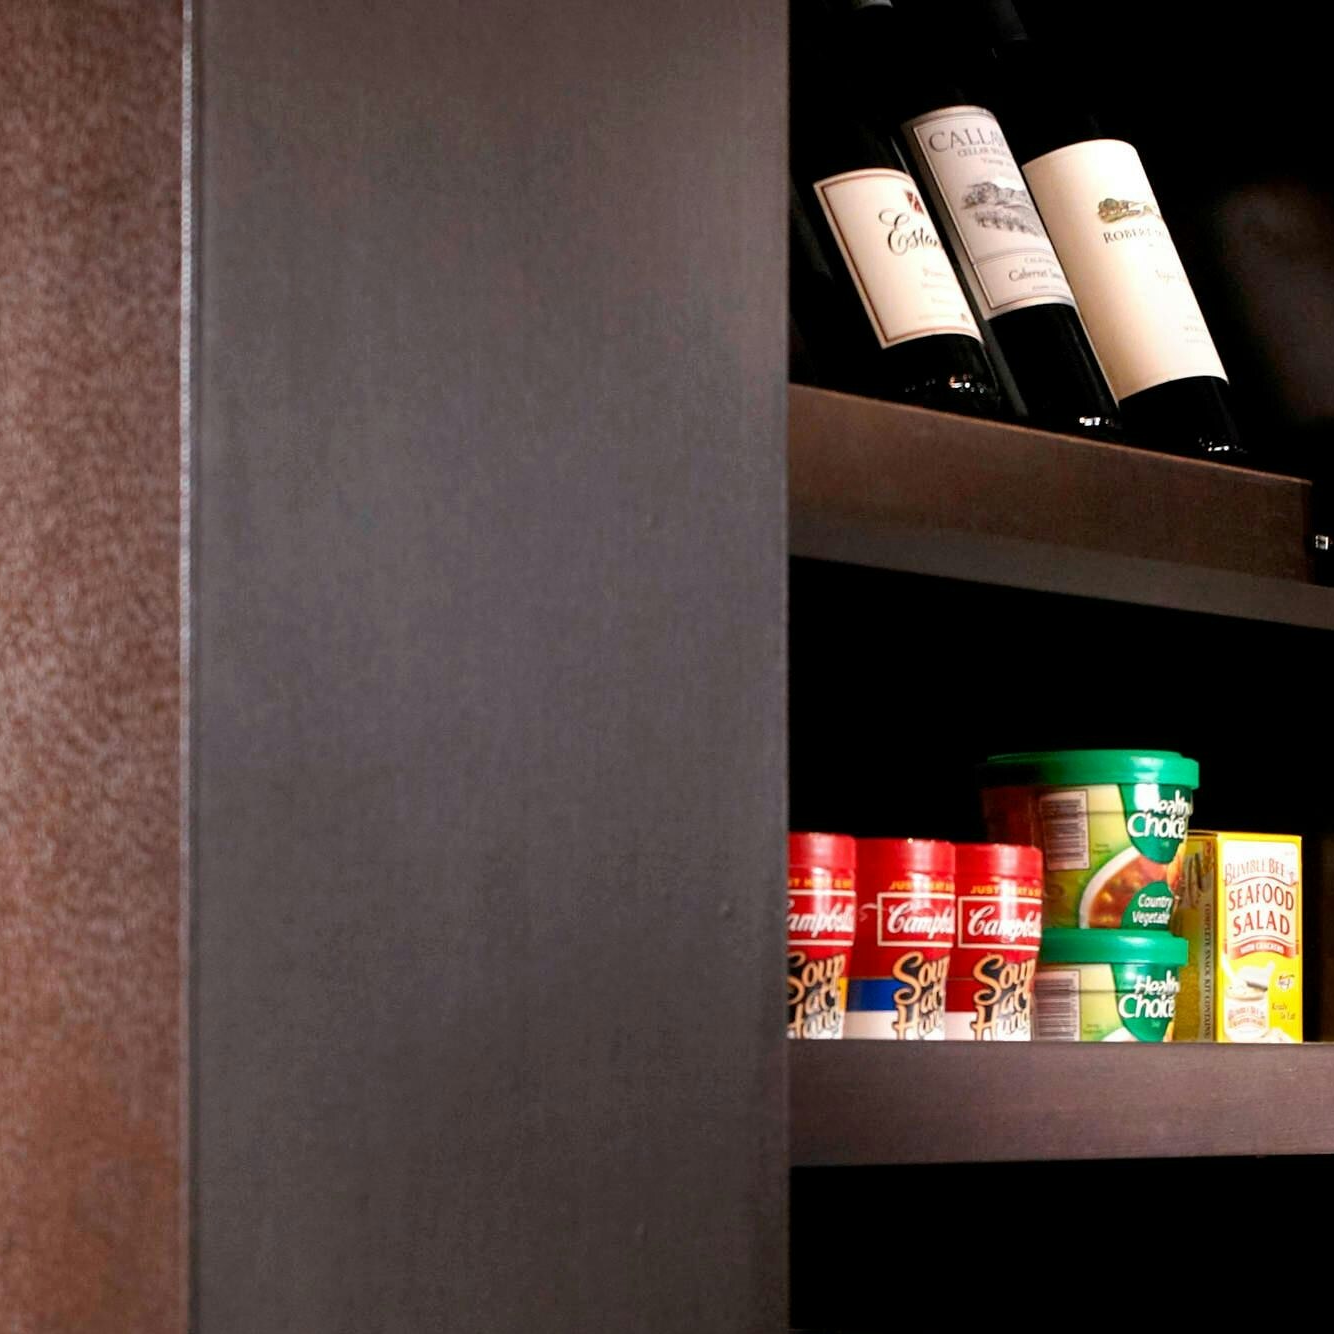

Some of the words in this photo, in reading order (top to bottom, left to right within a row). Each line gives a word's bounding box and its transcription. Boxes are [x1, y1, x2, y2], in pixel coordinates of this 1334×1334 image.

[1127, 811, 1185, 839] Choice
[1228, 883, 1294, 911] SEAFOOD
[1233, 910, 1290, 937] SALAD
